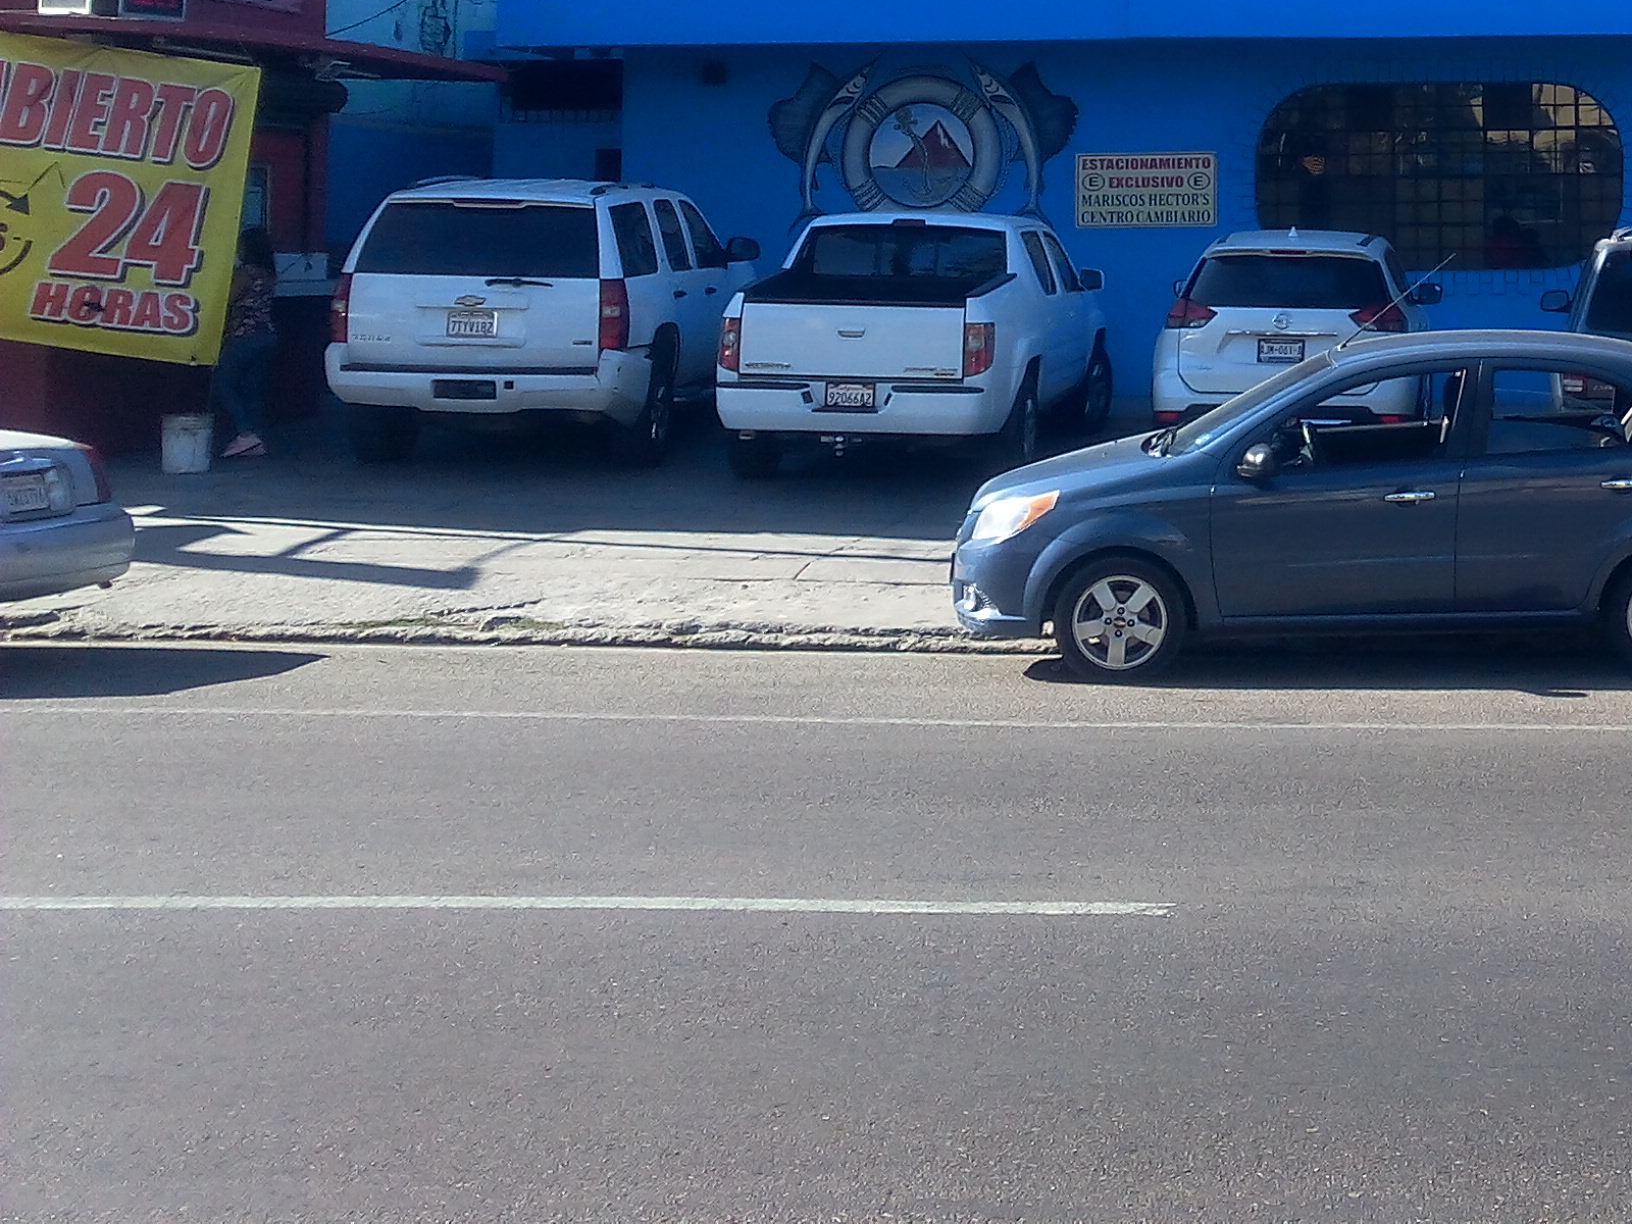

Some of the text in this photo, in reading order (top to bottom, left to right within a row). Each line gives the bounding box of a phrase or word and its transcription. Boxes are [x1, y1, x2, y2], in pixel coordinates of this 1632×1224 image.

[0, 59, 235, 170] BIERTO
[1081, 157, 1211, 171] ESTACIONAMIENTO
[1109, 176, 1184, 188] EXCLUSIVO
[1081, 194, 1146, 207] MARISCOS
[1081, 210, 1211, 224] CENTRO CAMBIARIO
[47, 170, 210, 286] 24
[29, 280, 198, 335] HORAS
